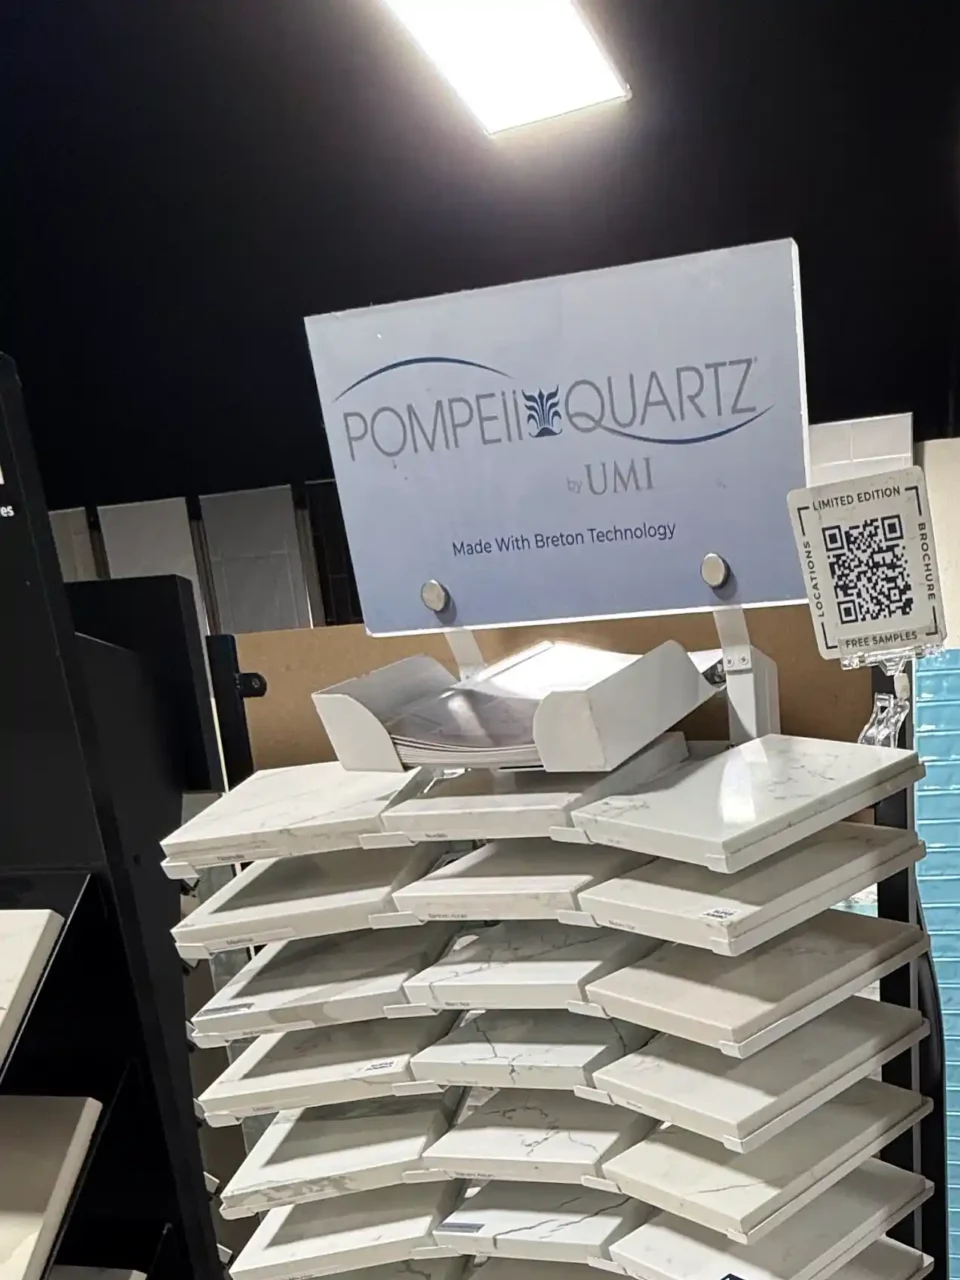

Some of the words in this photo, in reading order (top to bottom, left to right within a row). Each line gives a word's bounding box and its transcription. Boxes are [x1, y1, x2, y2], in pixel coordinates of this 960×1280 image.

[563, 357, 758, 434] QUARTZ
[567, 476, 583, 495] by
[584, 457, 653, 498] UMI
[812, 494, 854, 511] LIMITED
[857, 485, 900, 503] EDITION
[452, 539, 493, 558] Made
[494, 533, 532, 553] With
[535, 527, 585, 549] Breton
[587, 520, 677, 546] Technology
[803, 541, 825, 618] LOCATIONS
[918, 522, 936, 601] BROCHURE
[845, 637, 870, 649] FREE
[872, 631, 917, 646] SAMPLES
